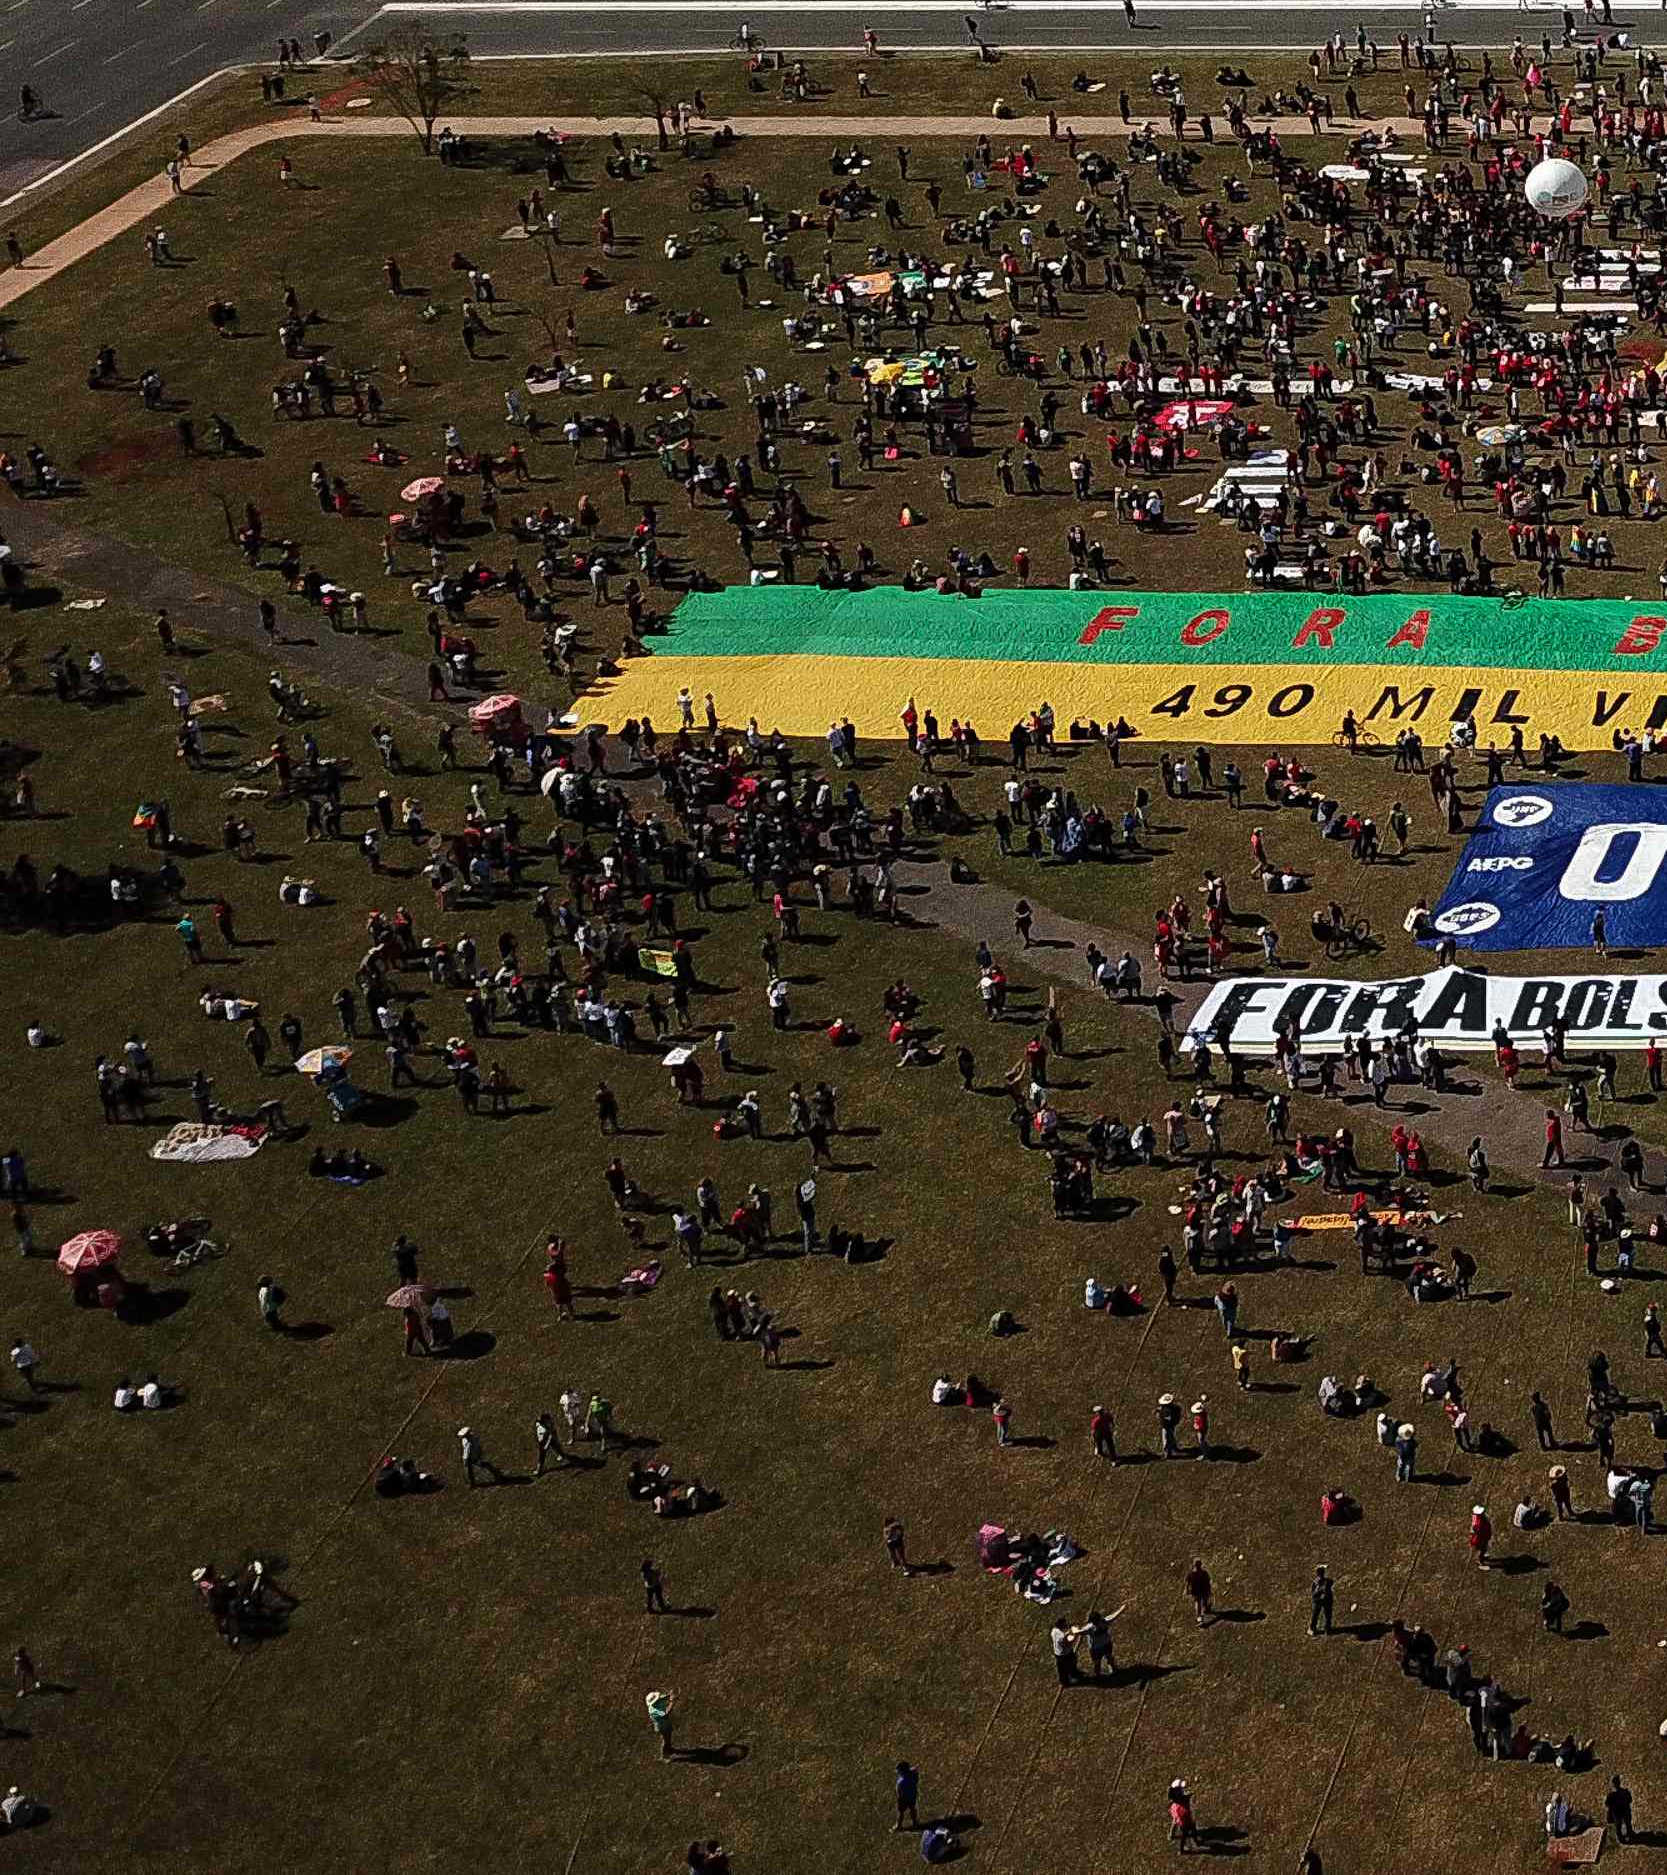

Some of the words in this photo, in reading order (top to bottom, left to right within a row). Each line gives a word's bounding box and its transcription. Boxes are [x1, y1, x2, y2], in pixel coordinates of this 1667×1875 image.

[1078, 607, 1430, 649] FORA
[1149, 684, 1315, 718] 490
[1366, 686, 1531, 724] MIL
[1210, 972, 1487, 1036] FORA
